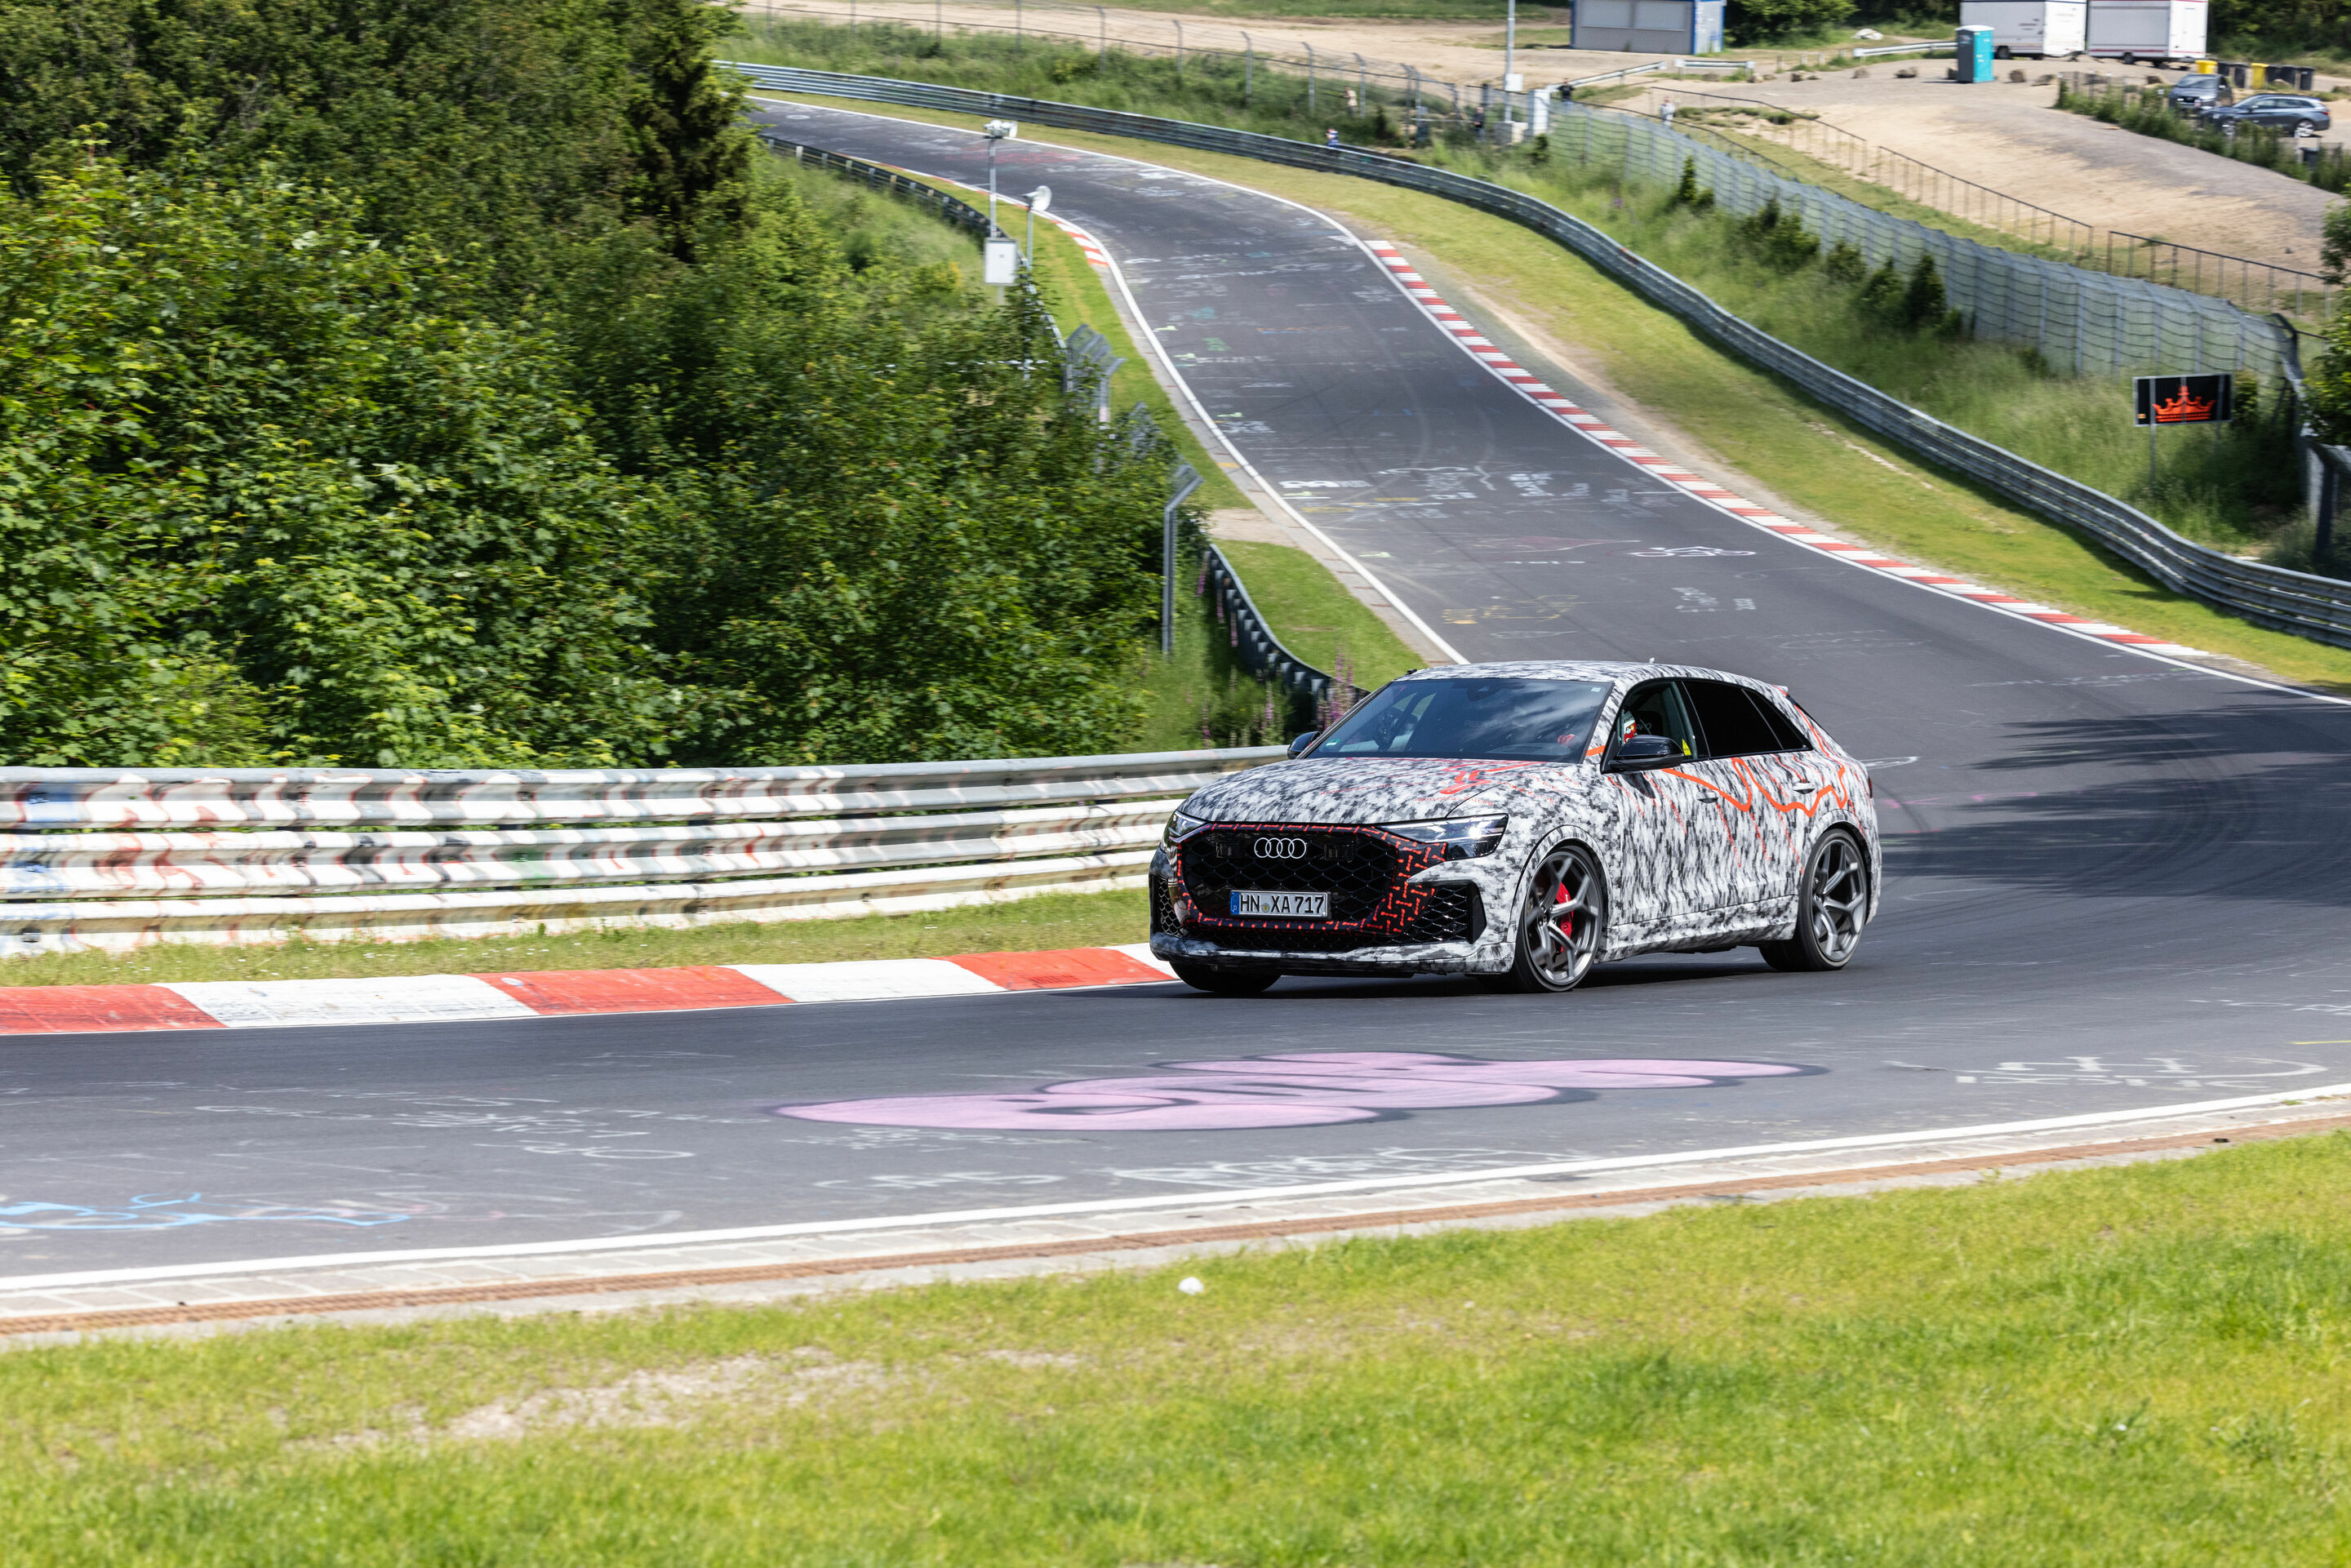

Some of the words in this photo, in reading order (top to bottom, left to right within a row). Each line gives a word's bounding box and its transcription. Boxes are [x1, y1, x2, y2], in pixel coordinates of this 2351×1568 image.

[1240, 895, 1260, 913] HN
[1270, 895, 1291, 913] XA
[1295, 895, 1325, 914] 717
